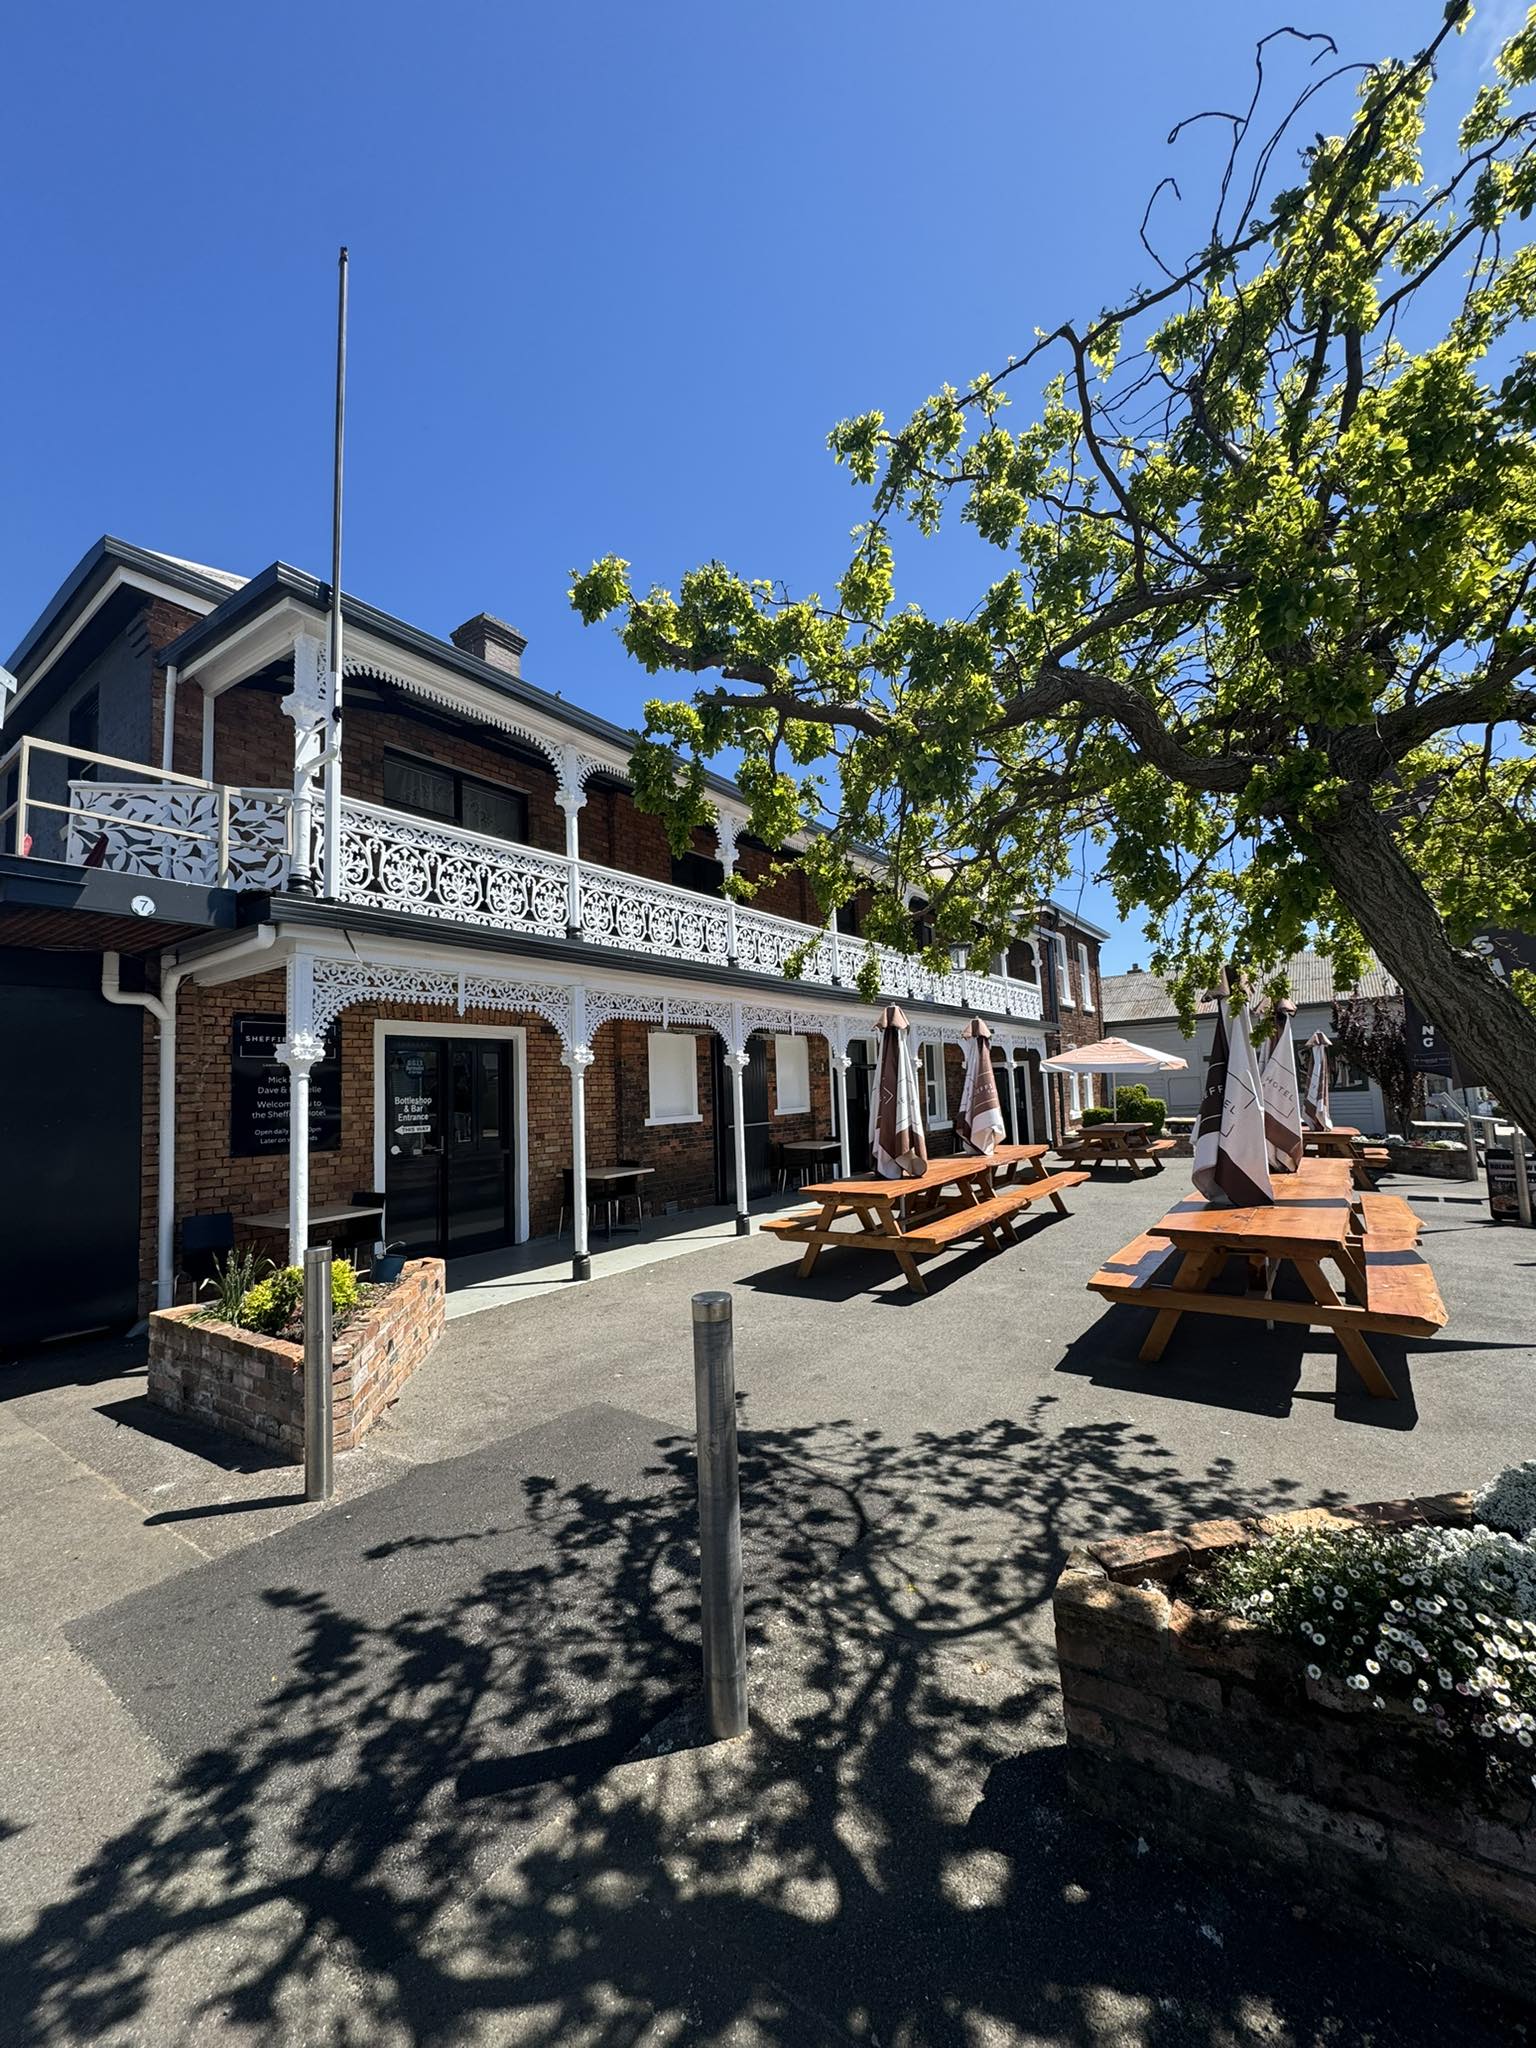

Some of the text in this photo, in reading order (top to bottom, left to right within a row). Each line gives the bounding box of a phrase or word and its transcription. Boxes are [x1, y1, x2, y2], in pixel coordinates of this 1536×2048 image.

[140, 900, 148, 911] 7
[268, 1076, 287, 1084] Mick
[257, 1086, 279, 1094] Dave
[1266, 1077, 1294, 1101] HOTEL
[257, 1101, 291, 1109] Welcom
[394, 1097, 432, 1105] Bottleshop
[252, 1111, 267, 1119] the
[398, 1113, 429, 1121] Entrance
[274, 1128, 289, 1136] daily
